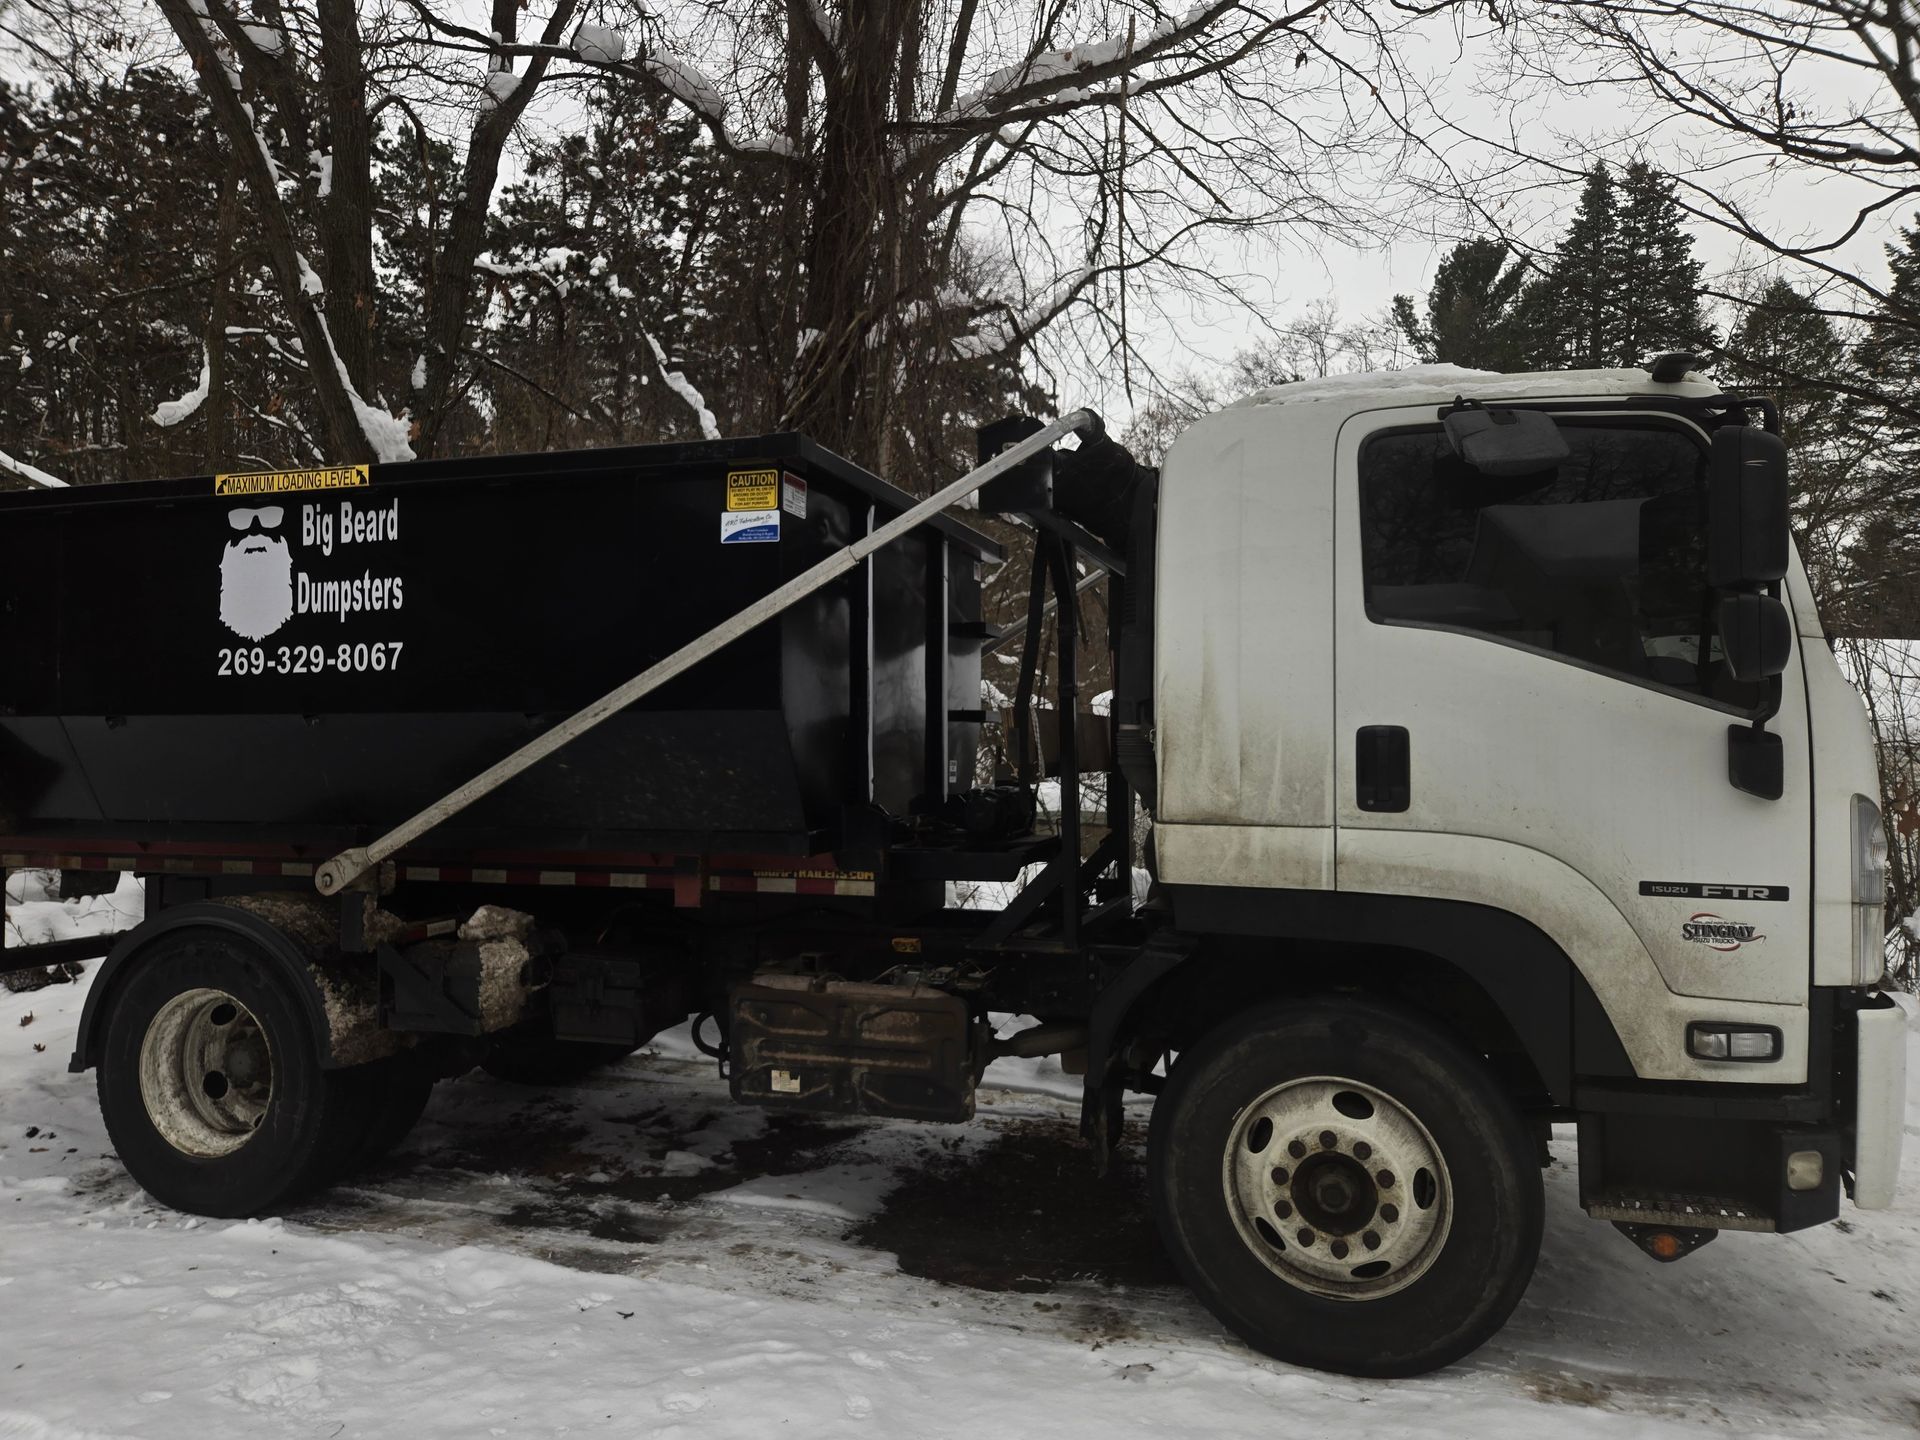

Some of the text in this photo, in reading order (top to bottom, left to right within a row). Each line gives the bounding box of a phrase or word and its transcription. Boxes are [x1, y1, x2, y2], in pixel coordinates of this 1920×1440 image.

[227, 470, 356, 493] MAXIMUM LOADING LEVEL
[731, 473, 774, 487] CAUTION
[302, 497, 398, 556] Big Beard
[297, 568, 403, 623] Dumpsters
[217, 641, 404, 676] 269-329-8067
[1652, 885, 1770, 899] ISUZU FTR
[1682, 923, 1756, 940] STINGRAY
